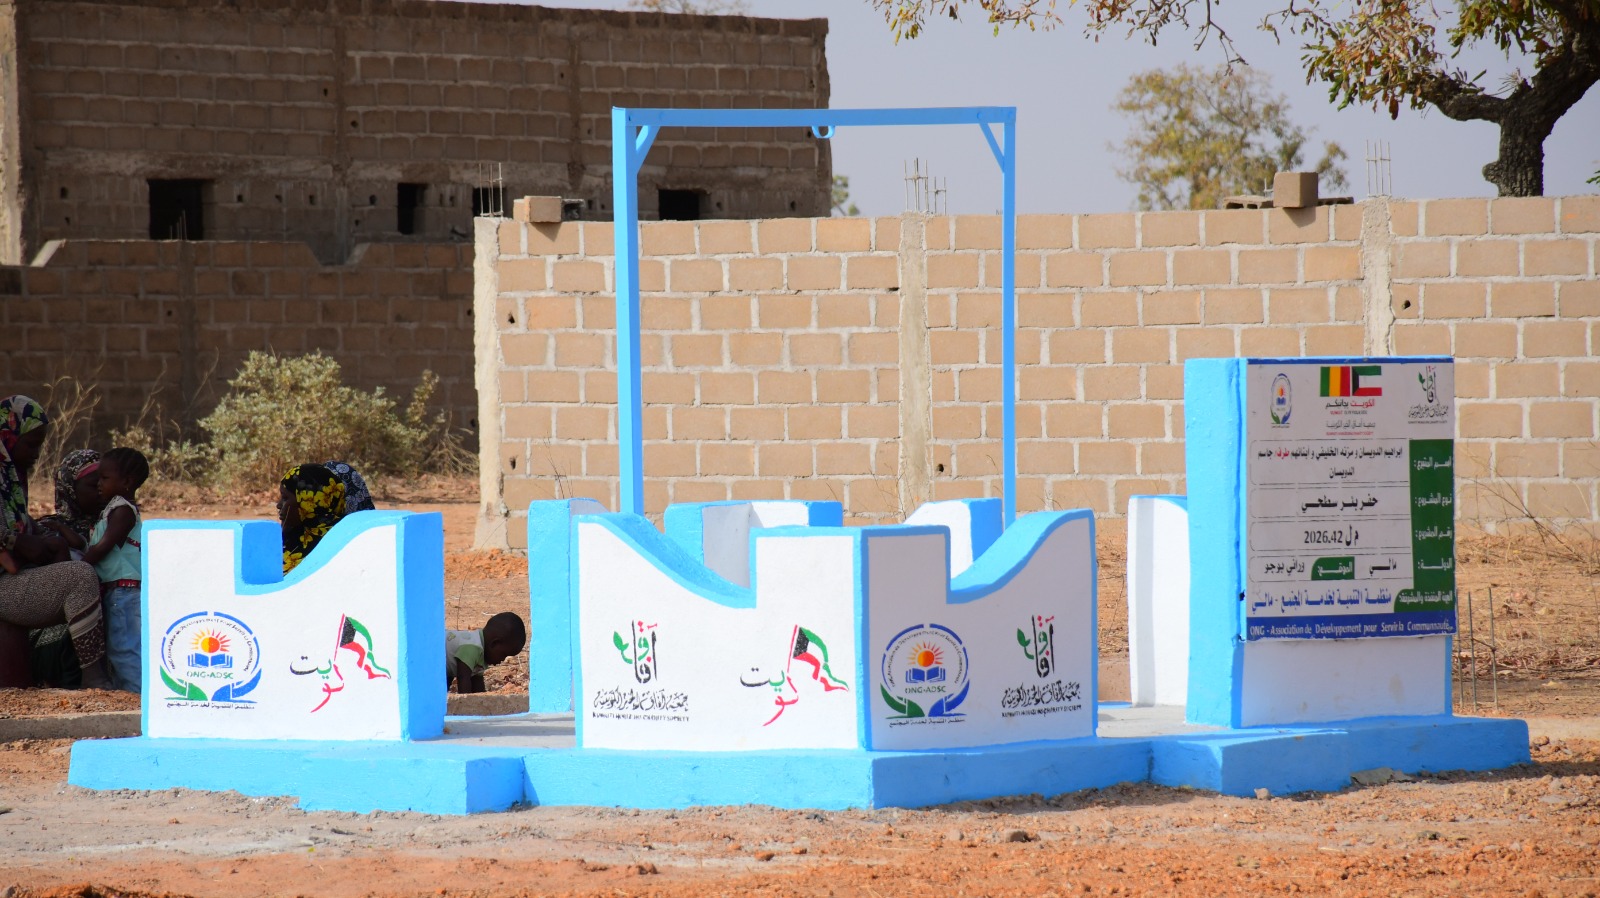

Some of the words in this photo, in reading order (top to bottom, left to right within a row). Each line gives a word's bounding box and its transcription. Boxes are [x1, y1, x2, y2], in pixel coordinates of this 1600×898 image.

[1301, 495, 1338, 513] سطحي
[1359, 493, 1378, 510] حفر
[1304, 530, 1343, 544] 2026.42
[1345, 525, 1352, 546] ل
[1354, 530, 1359, 546] م
[1336, 588, 1363, 610] التنمية
[1365, 588, 1392, 604] منظمة
[1271, 624, 1304, 635] Association
[1305, 623, 1312, 634] de
[1363, 623, 1377, 634] pour
[1381, 621, 1398, 632] Servir
[187, 671, 234, 679] ONG-ADSC
[905, 686, 946, 694] ONG-ADSC
